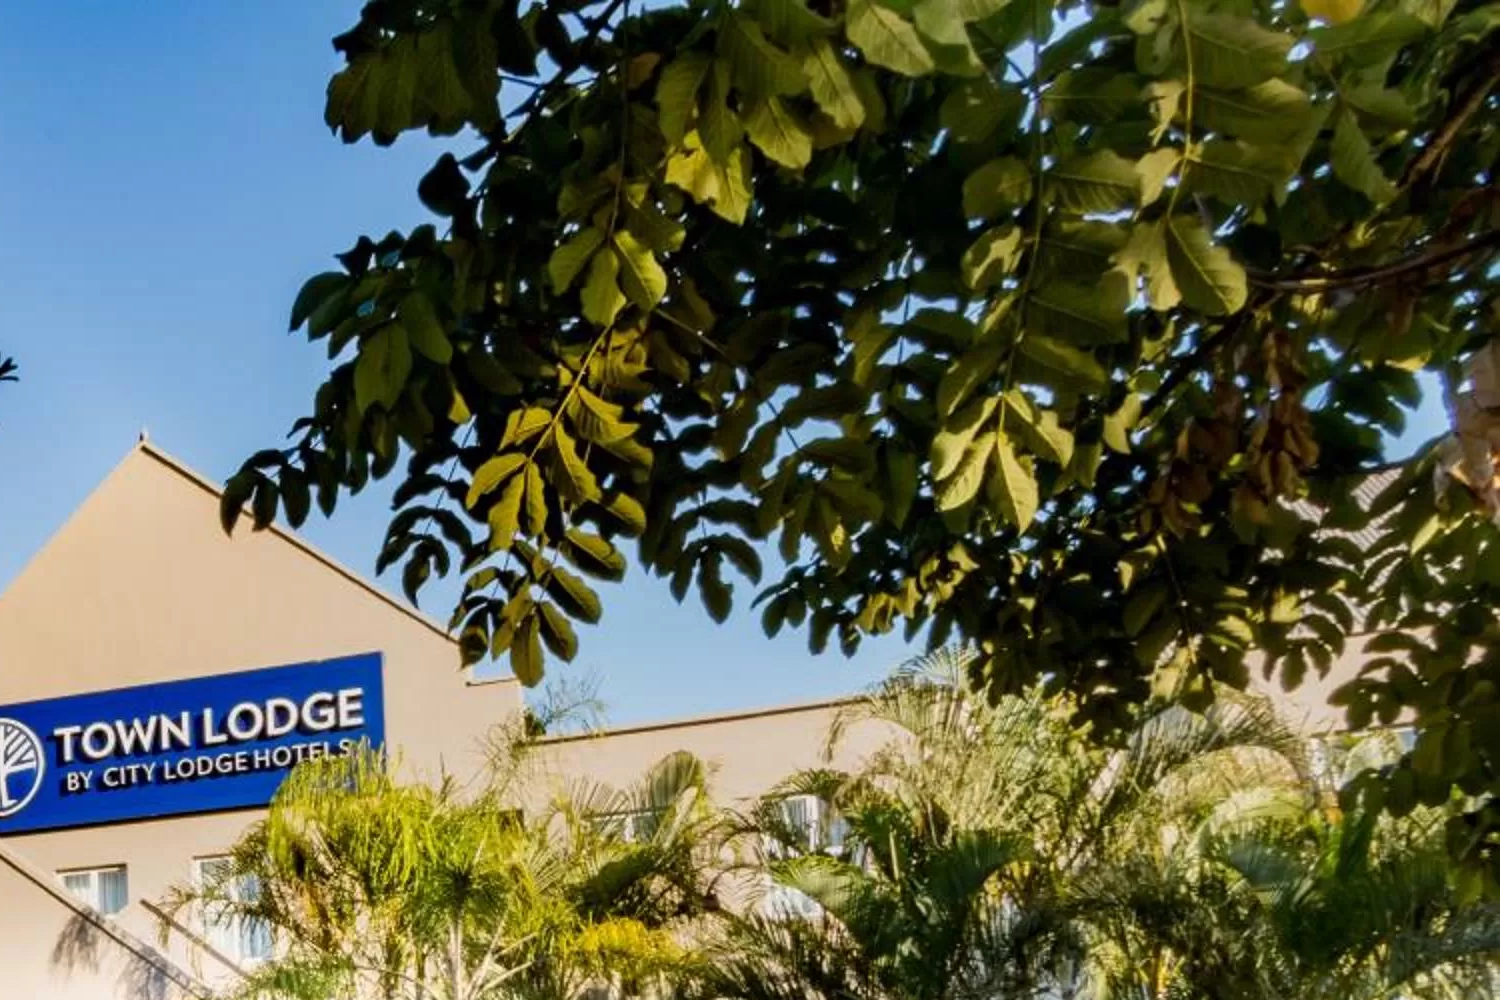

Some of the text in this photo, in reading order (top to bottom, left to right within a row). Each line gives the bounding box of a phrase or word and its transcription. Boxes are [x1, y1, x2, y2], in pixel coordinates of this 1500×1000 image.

[54, 688, 365, 762] TOWN LODGE
[67, 739, 352, 792] BY CITY LODGE HOTELS
